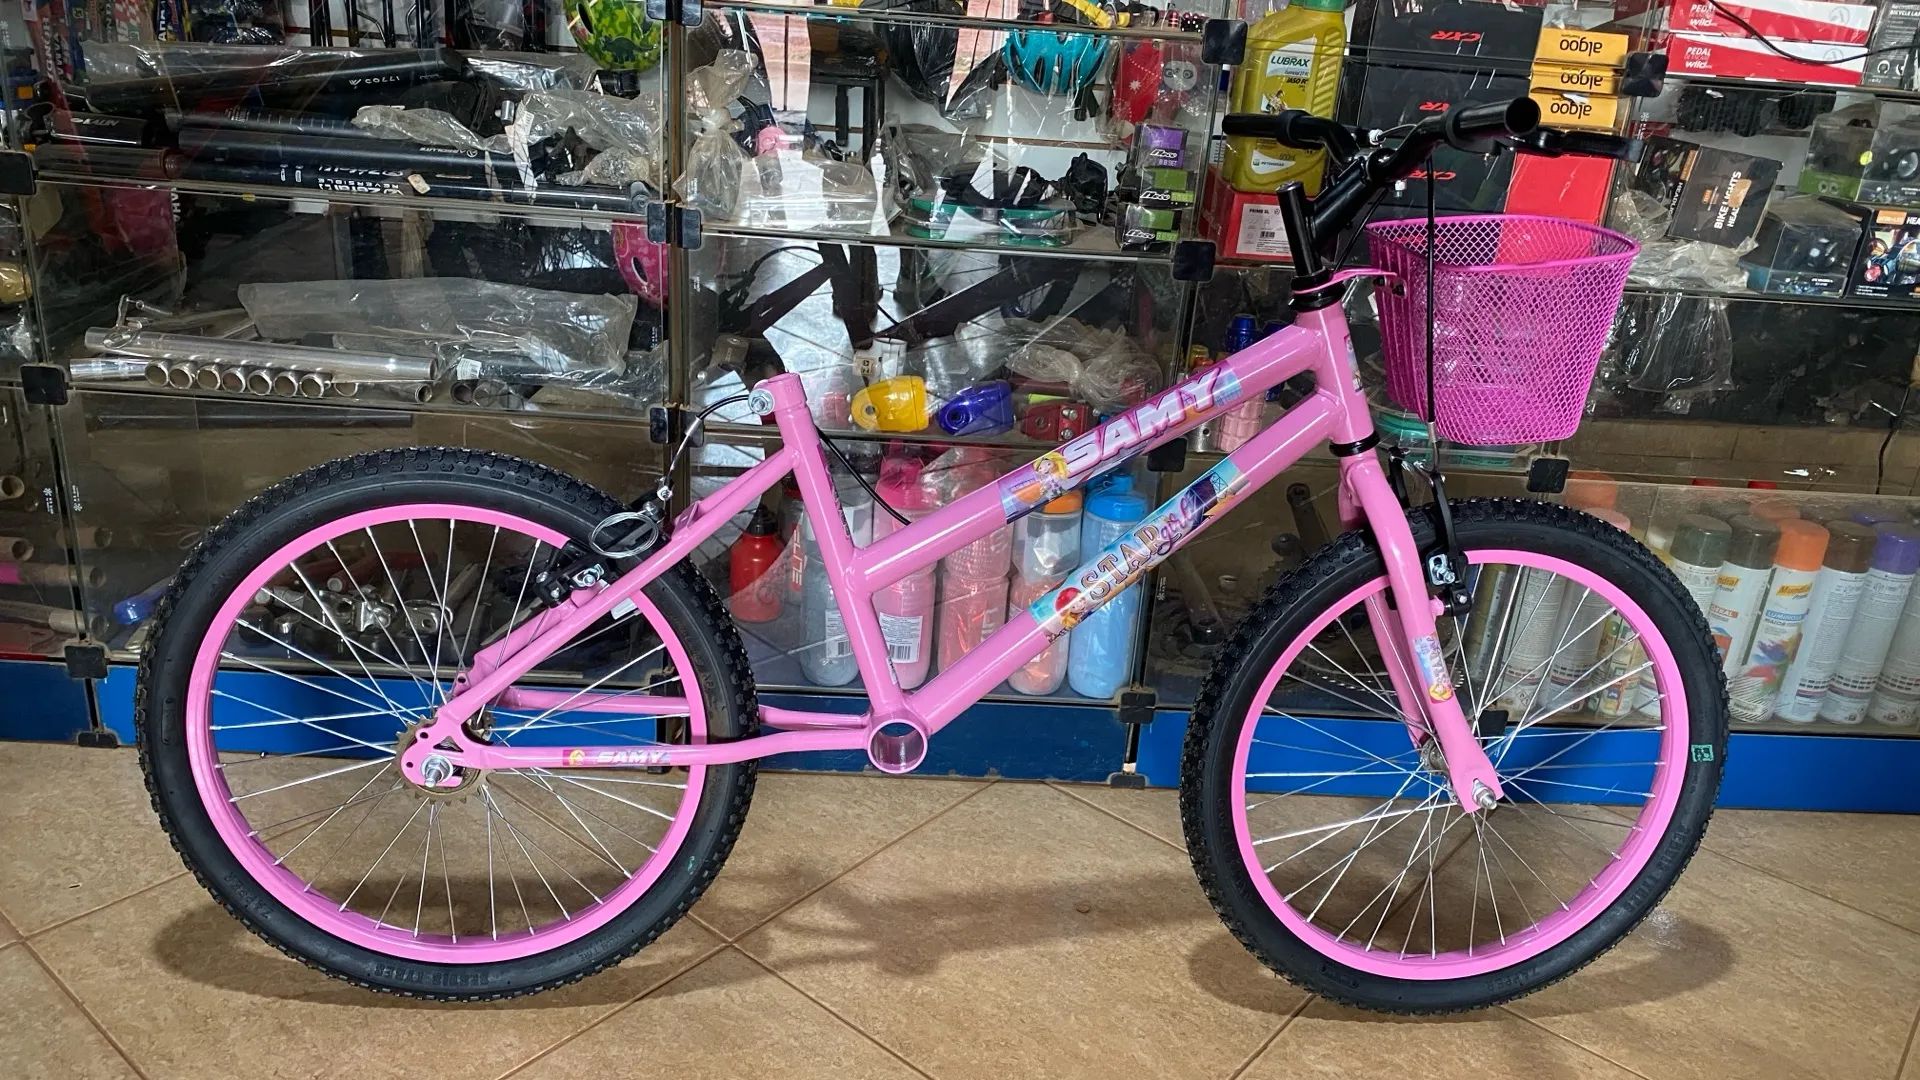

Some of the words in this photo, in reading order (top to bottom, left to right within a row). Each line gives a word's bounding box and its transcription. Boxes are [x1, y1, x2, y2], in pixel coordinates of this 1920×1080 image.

[1430, 30, 1481, 42] CXR
[1560, 37, 1603, 56] algoo
[1686, 47, 1712, 56] PEDAL
[1271, 55, 1311, 67] LUBRAX
[365, 75, 400, 84] COLLI
[1561, 70, 1604, 89] algoo
[1551, 102, 1592, 119] algoo
[317, 177, 399, 189] REVERSIBLE
[1713, 204, 1729, 230] BIKE
[1061, 366, 1222, 474] SAMY
[1081, 523, 1181, 601] STAR
[597, 750, 664, 764] SAMY
